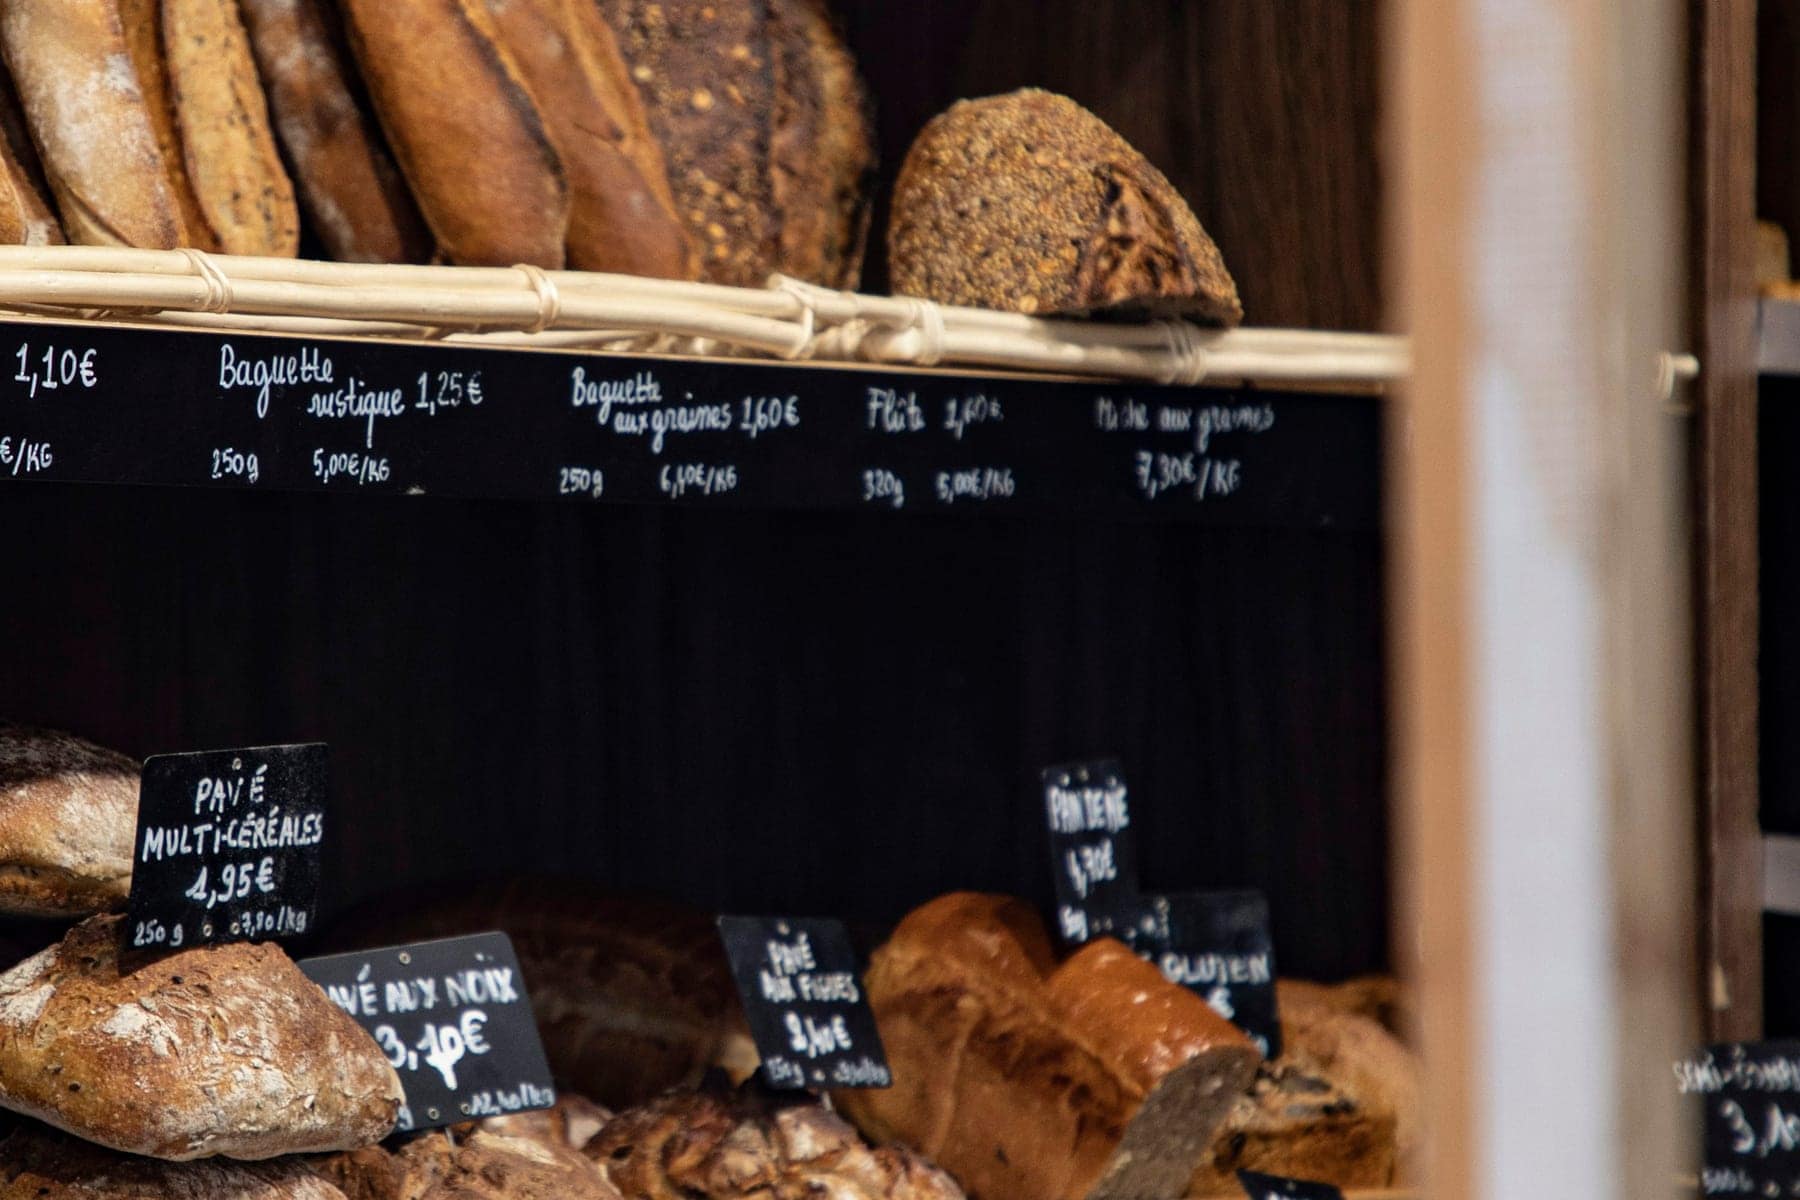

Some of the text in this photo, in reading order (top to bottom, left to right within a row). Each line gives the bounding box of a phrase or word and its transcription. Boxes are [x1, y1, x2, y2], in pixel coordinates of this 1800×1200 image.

[15, 342, 97, 398] 1,10€
[220, 343, 334, 418] Baguette
[572, 366, 663, 425] Baguette
[307, 371, 484, 449] rustique 1,25€
[613, 391, 800, 454] aux graines 1,60€
[1159, 406, 1193, 431] aux
[211, 447, 390, 485] 250g 5,00€/KG
[559, 467, 603, 498] 250g
[194, 763, 268, 815] PAVÉ
[185, 856, 275, 909] 1,95€
[328, 962, 379, 1017] AVÉ
[384, 976, 440, 1014] AUX
[374, 1009, 492, 1090] 3,10€
